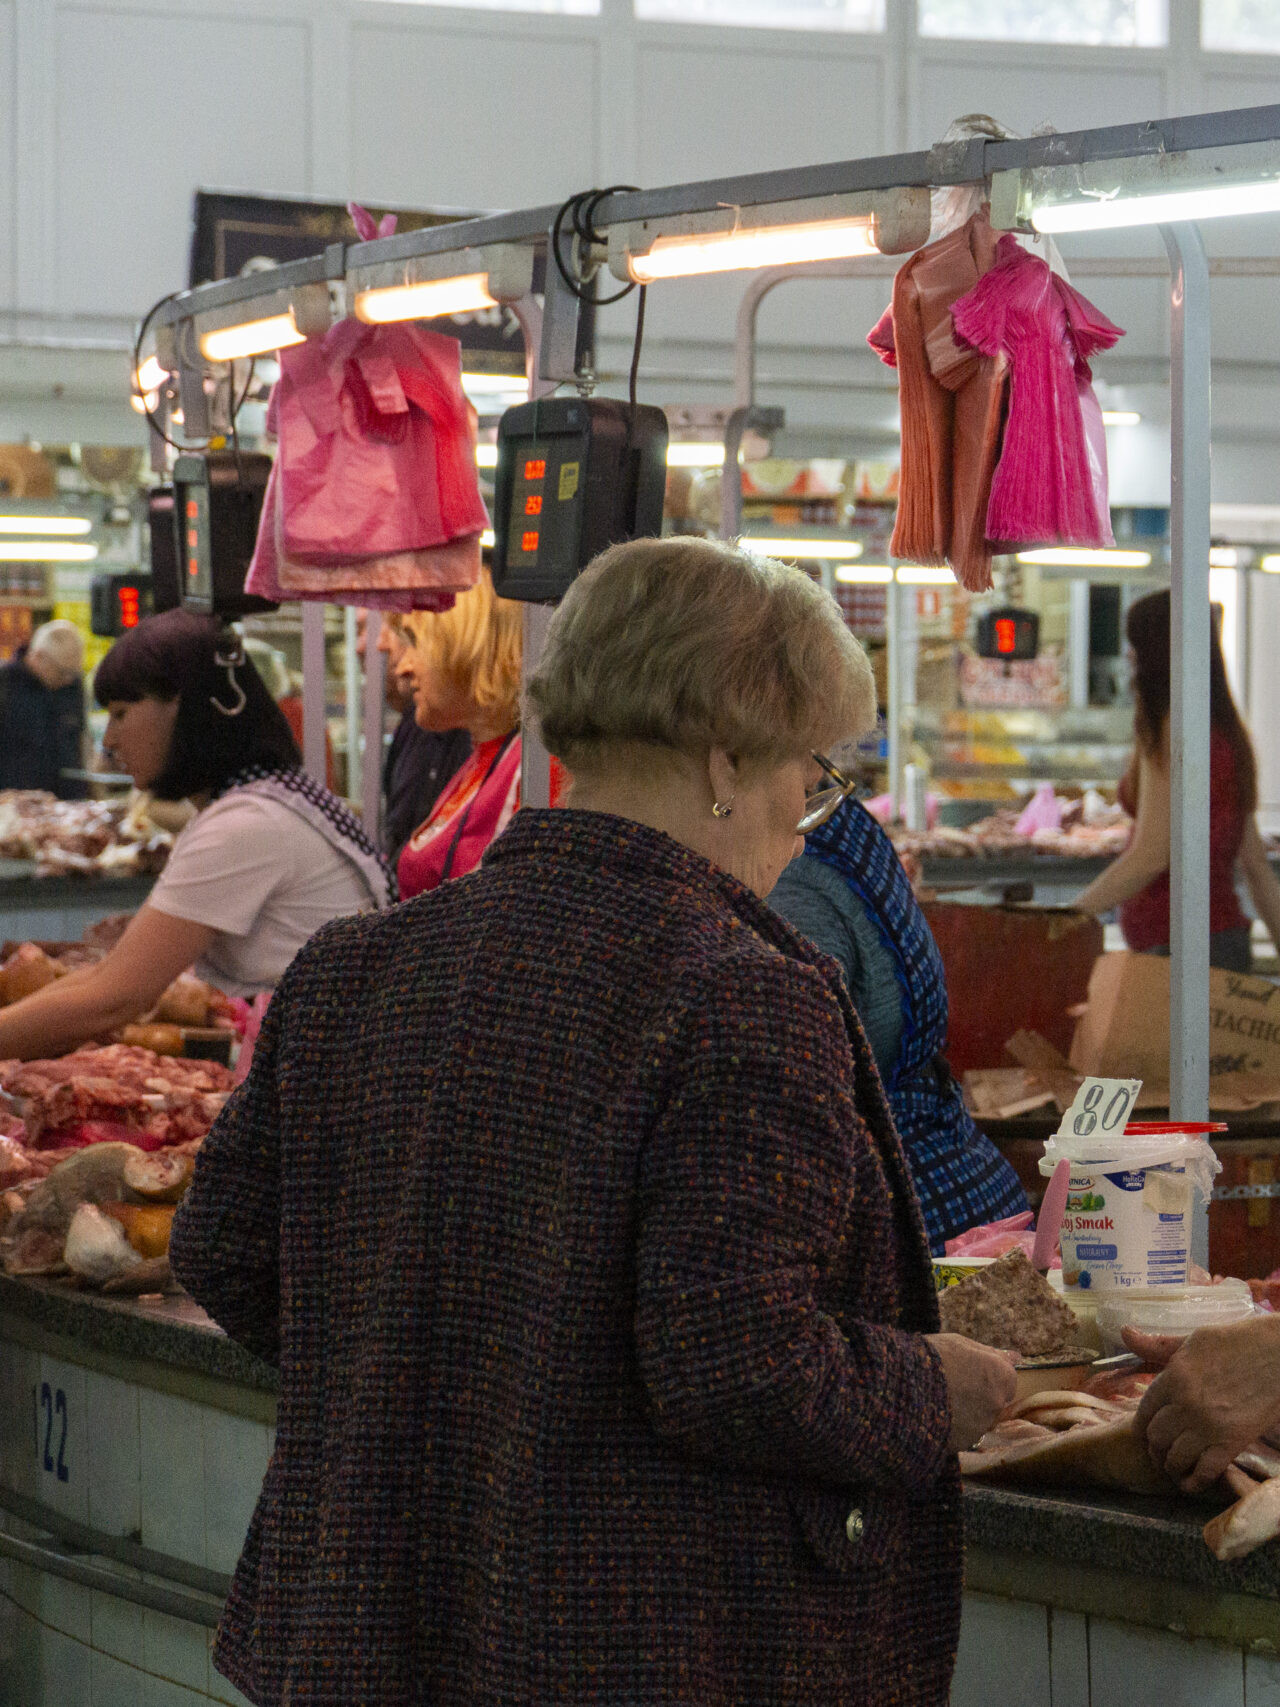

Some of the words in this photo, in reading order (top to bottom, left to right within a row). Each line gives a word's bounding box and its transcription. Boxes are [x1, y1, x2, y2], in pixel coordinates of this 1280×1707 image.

[1074, 1085, 1130, 1136] 80
[1075, 1216, 1114, 1230] Smak
[1120, 1275, 1131, 1288] kg
[41, 1382, 69, 1482] 22
